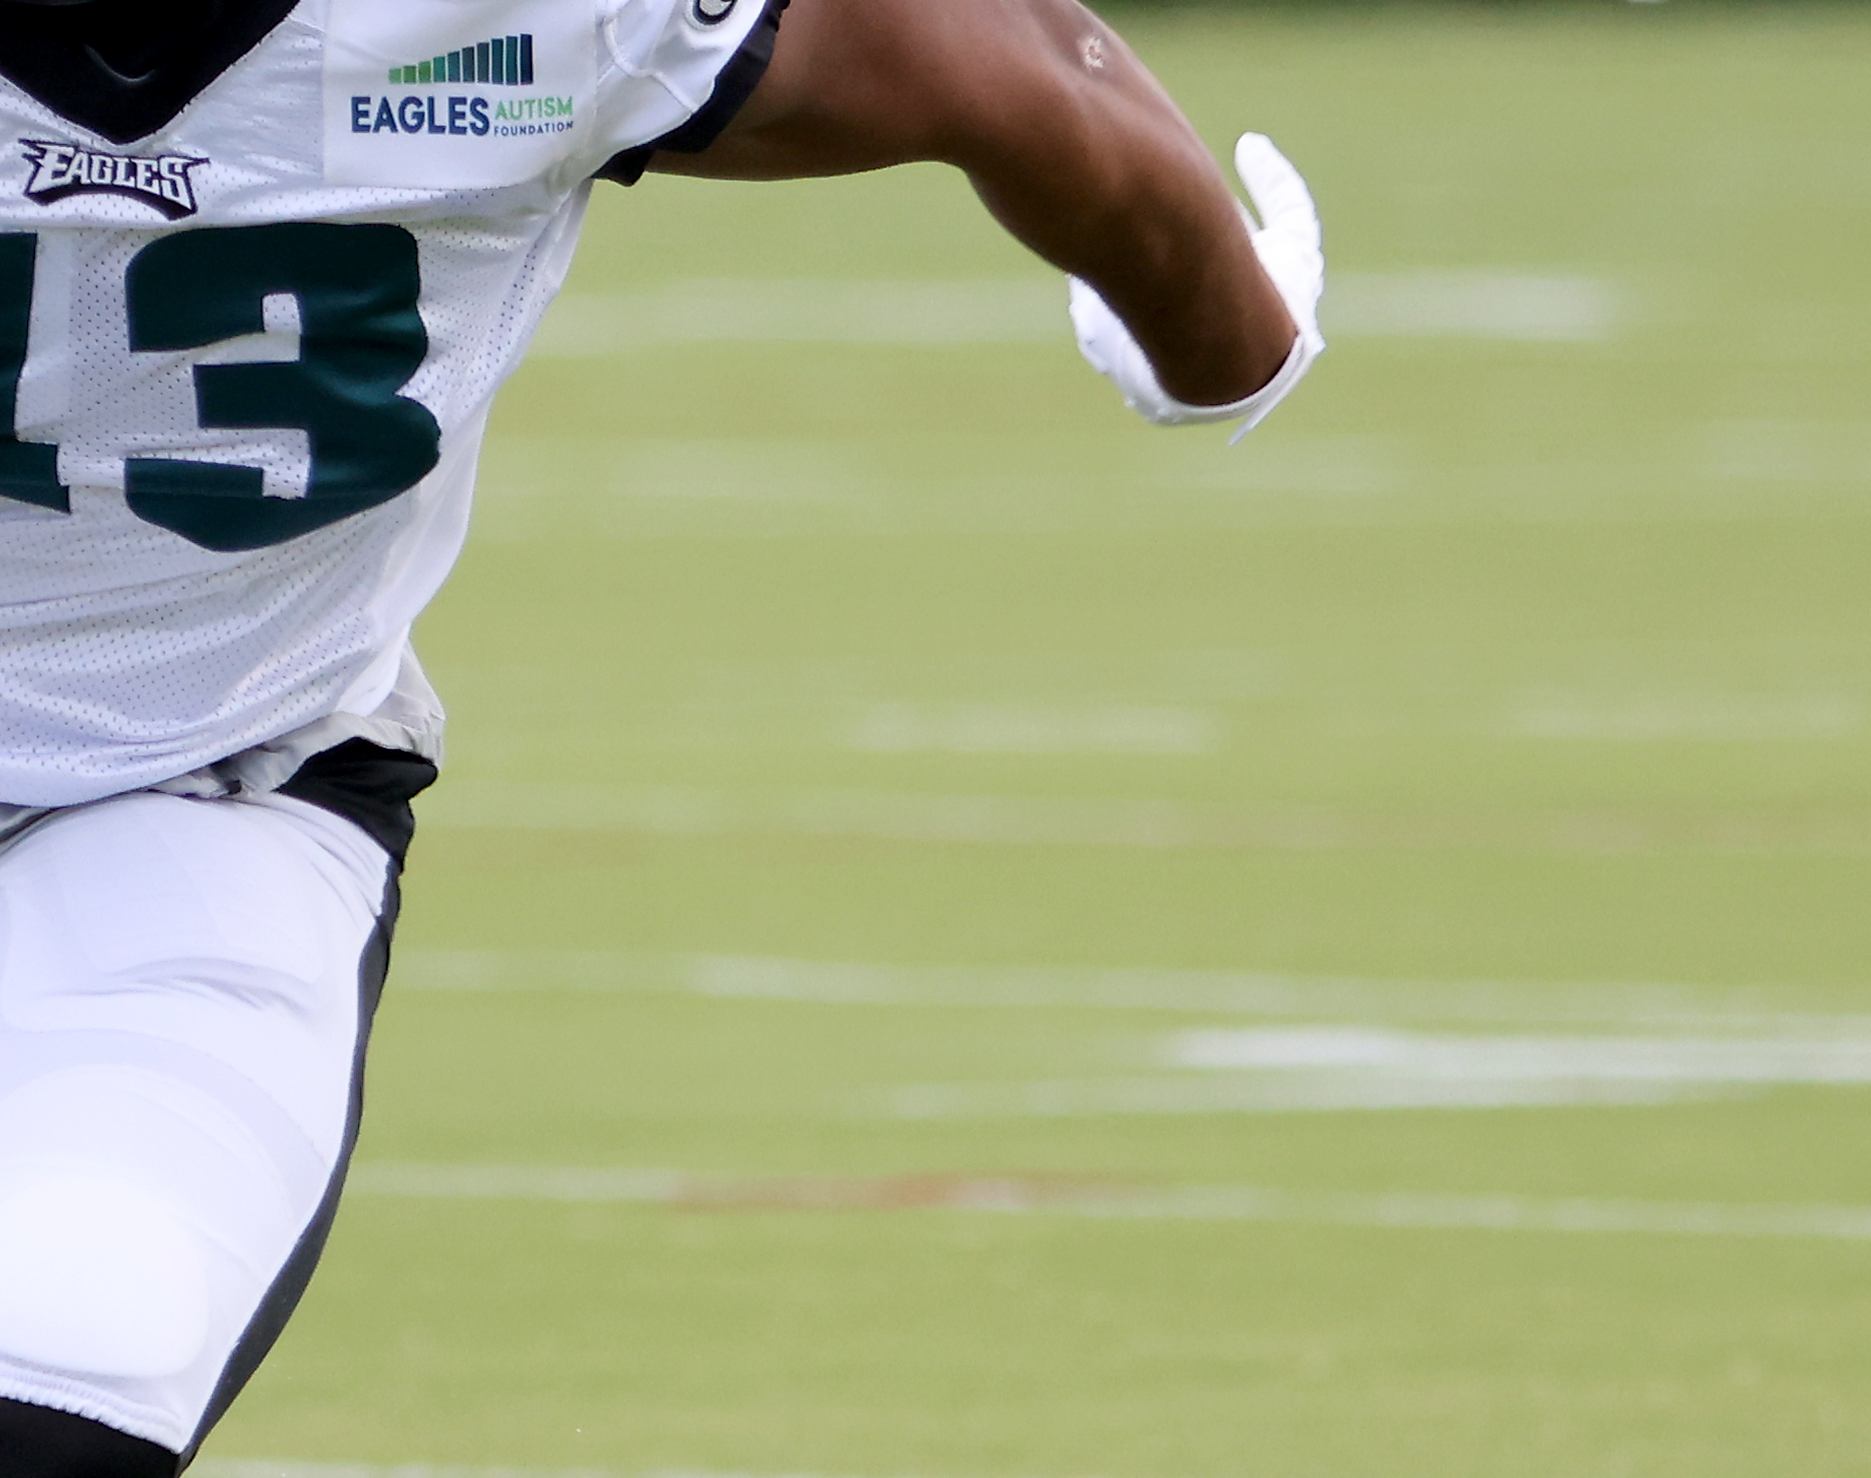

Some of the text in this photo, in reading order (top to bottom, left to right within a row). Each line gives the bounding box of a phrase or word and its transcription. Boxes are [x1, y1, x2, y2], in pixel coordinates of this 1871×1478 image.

[351, 96, 574, 136] EAGLES AUTISM
[494, 121, 574, 137] FOUNDATION
[21, 139, 204, 220] EAGLES
